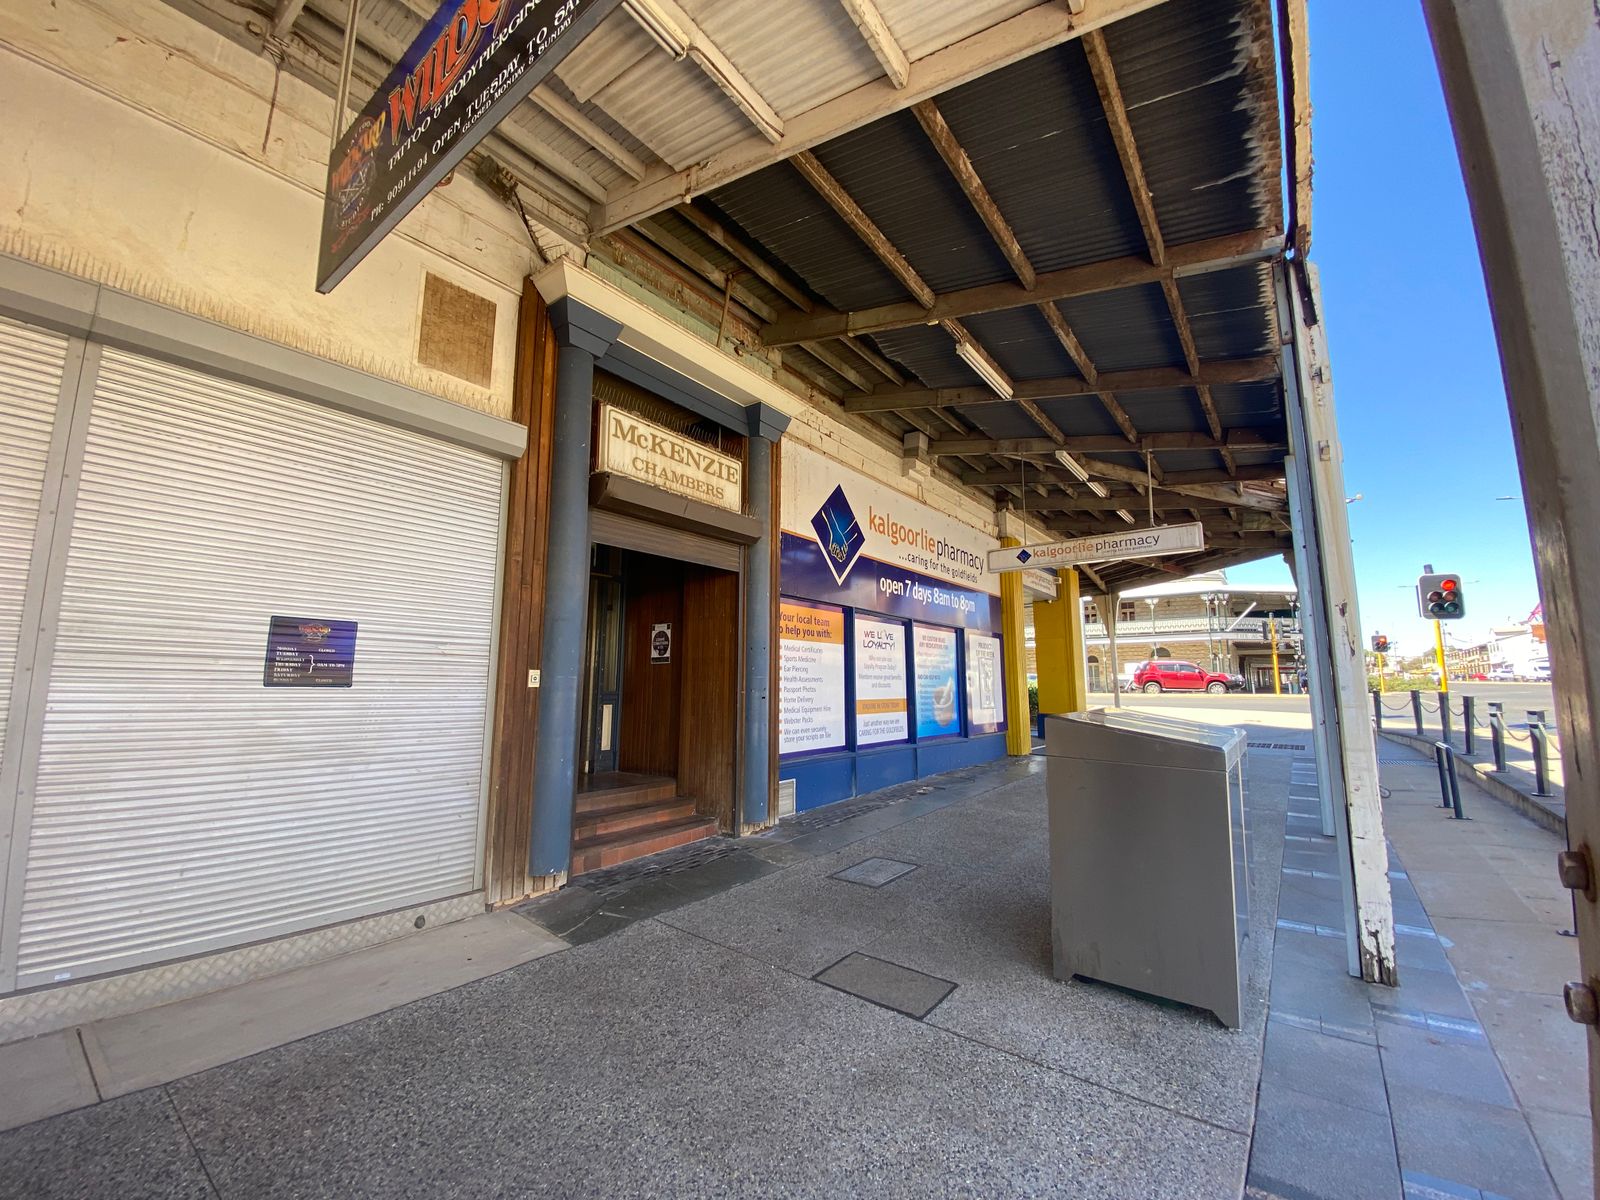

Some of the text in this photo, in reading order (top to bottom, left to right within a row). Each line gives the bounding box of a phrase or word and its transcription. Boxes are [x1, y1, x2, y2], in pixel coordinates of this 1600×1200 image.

[462, 14, 573, 133] CLOSED MONDAY & SUNDAY
[386, 0, 542, 171] TATTOO & BODYPIERCIN
[432, 117, 462, 155] OPEN
[466, 53, 521, 119] TUESDAY
[526, 27, 548, 55] TO
[611, 417, 739, 485] McKENZIE
[632, 456, 725, 501] CHAMBERS
[929, 558, 939, 571] for
[940, 562, 950, 575] the
[880, 577, 976, 615] open 7 days 8am to 8pm
[796, 613, 813, 625] local
[814, 618, 830, 627] team
[785, 624, 801, 638] help
[802, 629, 815, 639] you
[816, 629, 832, 639] with:
[863, 630, 876, 639] WE
[783, 644, 800, 653] Medical
[783, 655, 816, 664] Sports Medicine
[792, 665, 808, 674] Piercing
[783, 675, 798, 683] Health
[783, 686, 801, 694] Passport
[783, 696, 814, 705] Home Delivery
[783, 706, 800, 714] Medical
[783, 728, 791, 736] We
